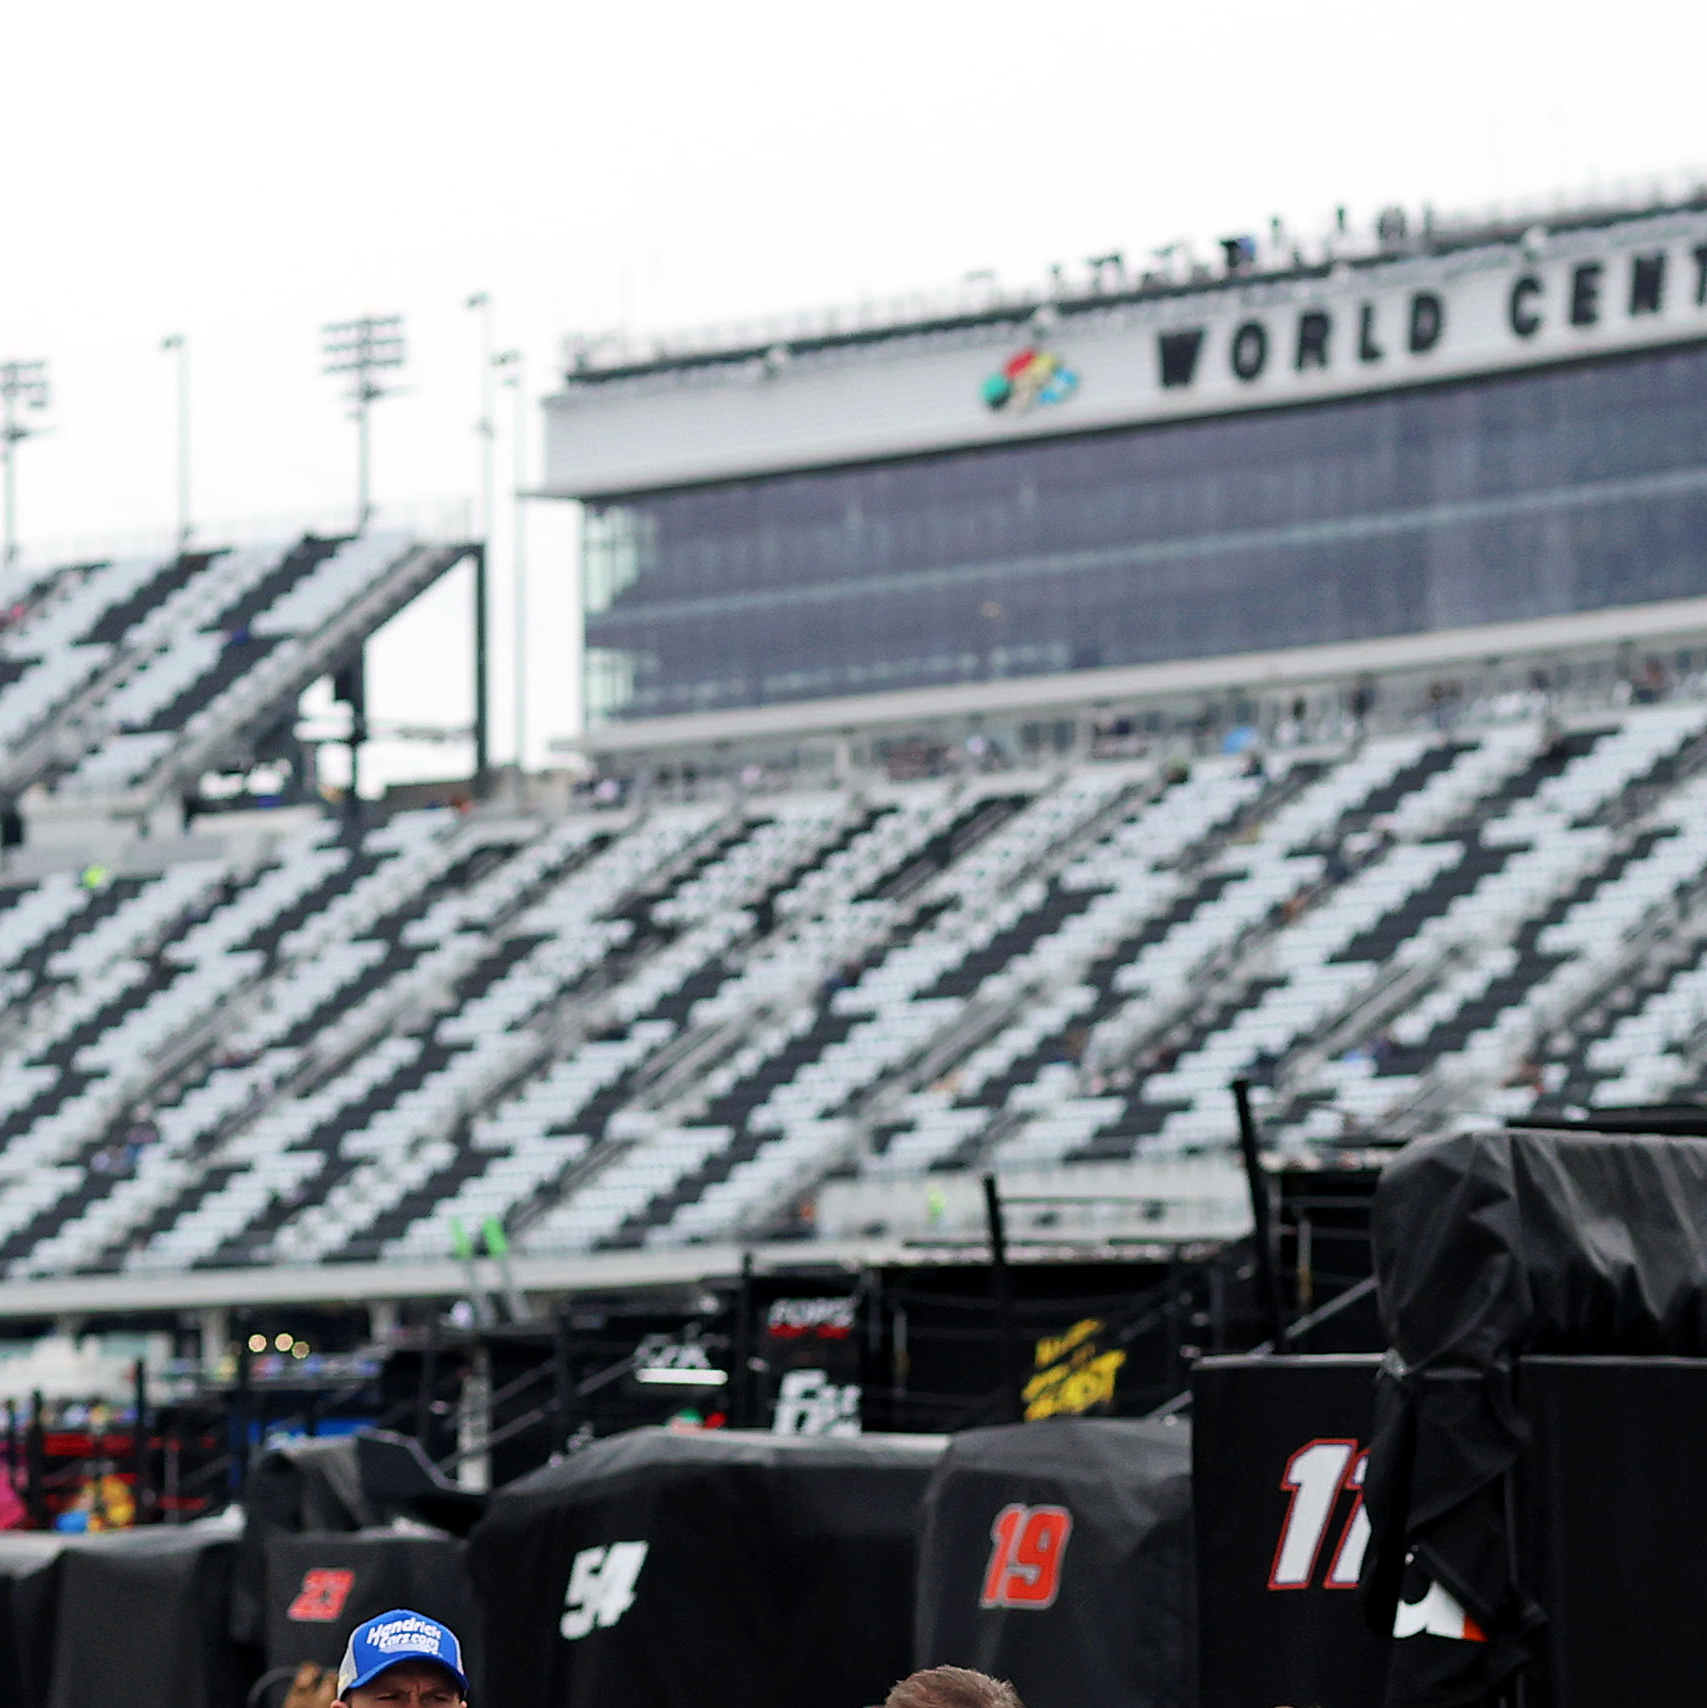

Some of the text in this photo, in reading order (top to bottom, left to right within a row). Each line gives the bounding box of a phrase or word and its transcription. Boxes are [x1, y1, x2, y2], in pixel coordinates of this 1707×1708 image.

[1159, 289, 1444, 389] WORLD
[560, 1541, 648, 1640] 54
[982, 1502, 1074, 1608] 19
[366, 1617, 442, 1646] Hendrick
